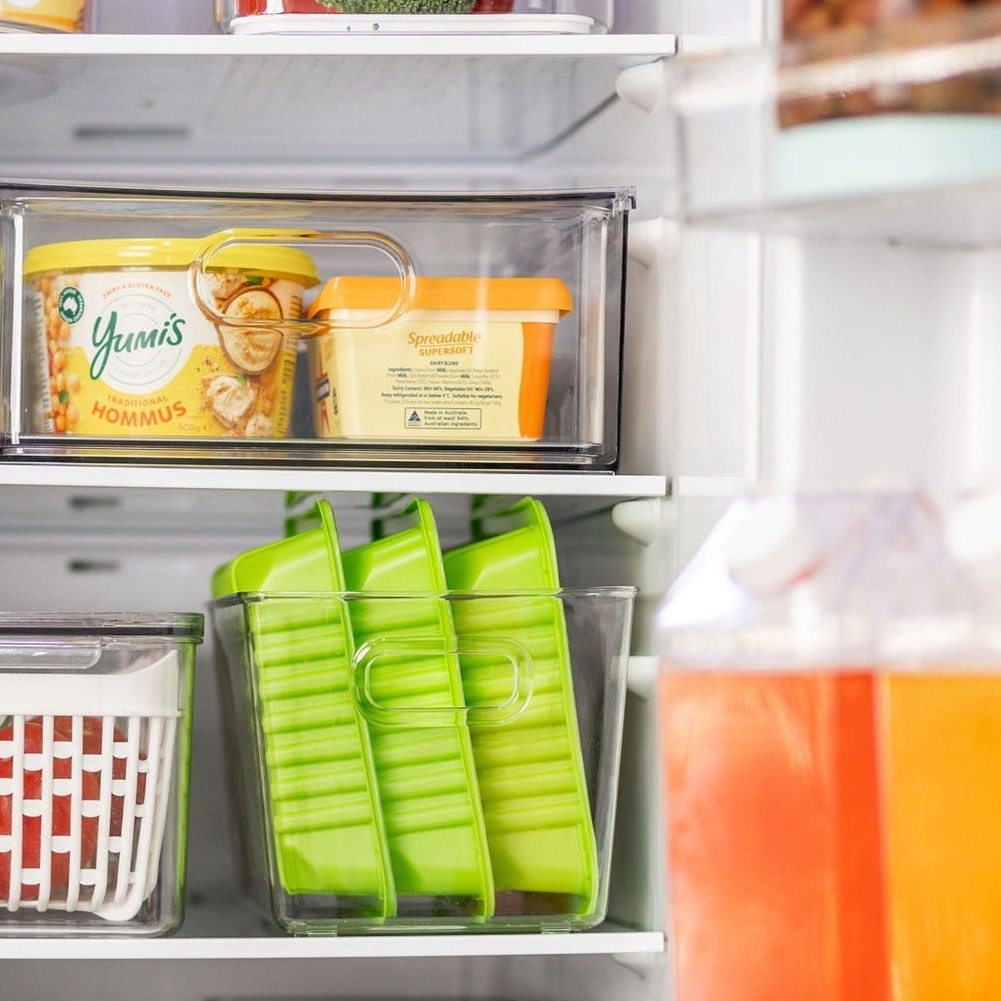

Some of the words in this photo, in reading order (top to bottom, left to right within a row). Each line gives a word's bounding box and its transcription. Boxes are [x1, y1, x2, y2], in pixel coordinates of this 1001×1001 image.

[89, 310, 186, 380] Yumi's
[407, 330, 482, 348] Spreadable
[419, 346, 474, 357] SUPERSOFT
[107, 395, 168, 407] TRADITIONAL
[91, 400, 187, 428] HOMMUS
